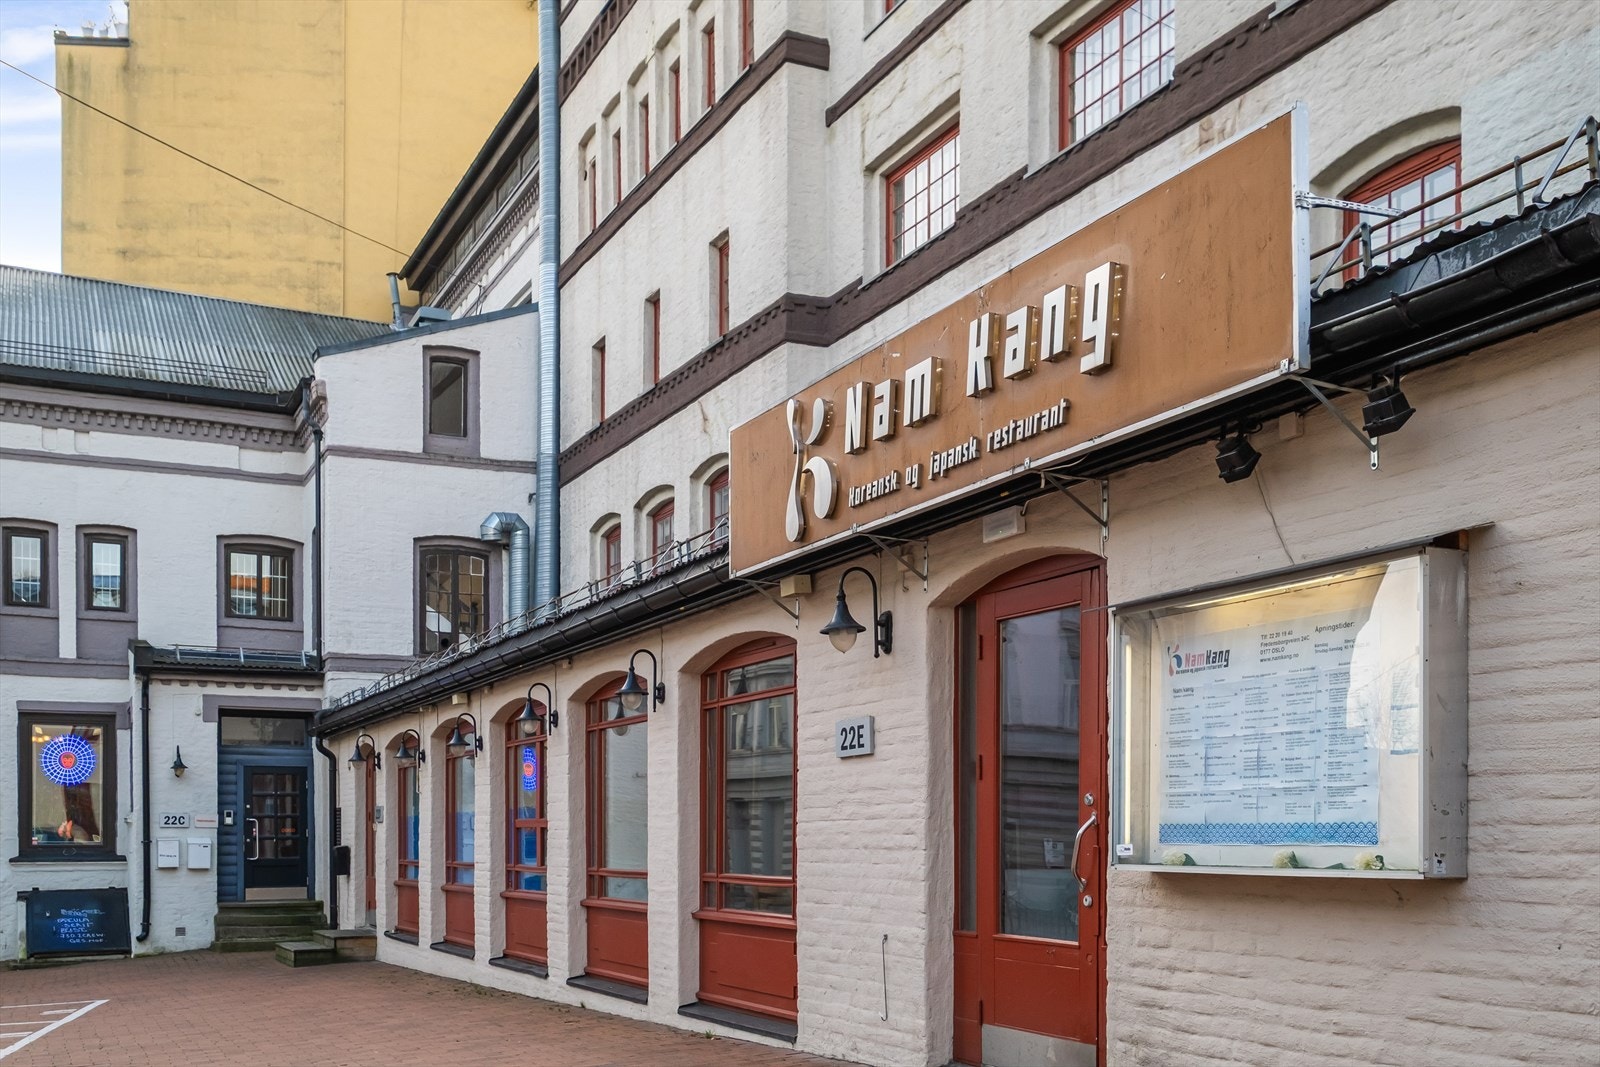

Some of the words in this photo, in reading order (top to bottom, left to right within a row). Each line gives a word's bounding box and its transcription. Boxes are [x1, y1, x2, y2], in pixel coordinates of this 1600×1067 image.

[844, 356, 941, 455] Nam
[966, 261, 1120, 397] Kang
[905, 463, 921, 489] og
[928, 436, 980, 481] japansk
[986, 398, 1070, 452] restaurant
[840, 724, 865, 751] 22E
[163, 815, 186, 826] 22C
